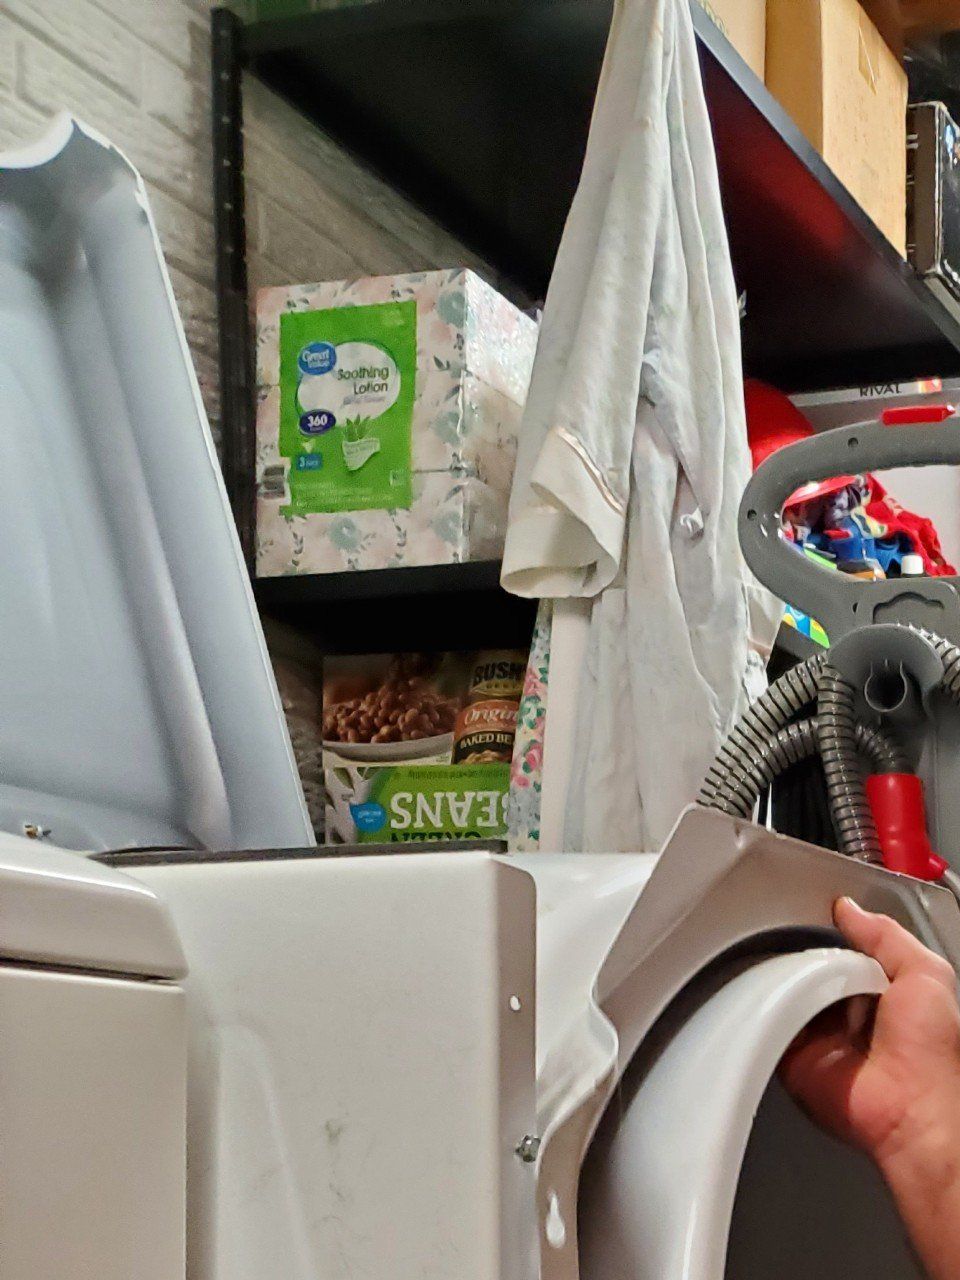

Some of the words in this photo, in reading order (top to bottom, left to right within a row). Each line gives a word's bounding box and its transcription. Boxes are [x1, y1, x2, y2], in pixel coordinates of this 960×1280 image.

[337, 366, 390, 380] Soothing
[353, 381, 388, 395] Lotion
[859, 384, 902, 397] RIVAL
[307, 414, 328, 427] 360
